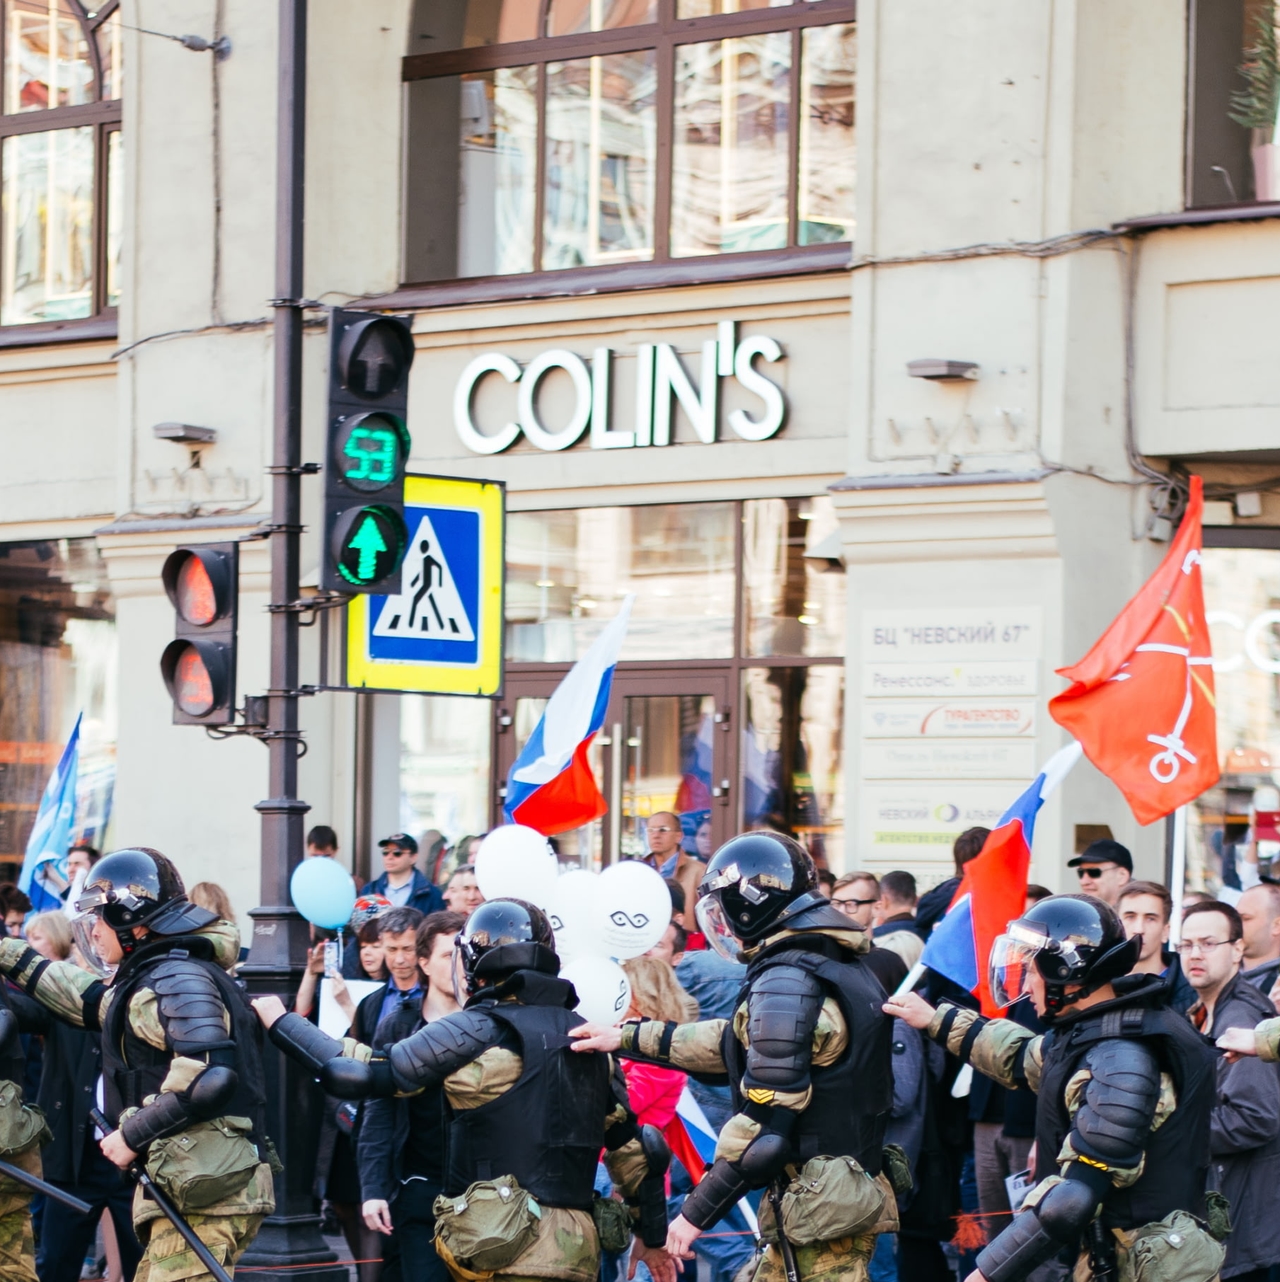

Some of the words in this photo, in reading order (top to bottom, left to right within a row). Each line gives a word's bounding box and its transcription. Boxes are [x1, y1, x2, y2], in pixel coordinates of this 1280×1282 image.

[454, 320, 786, 455] COLIN'S
[343, 428, 396, 481] 53
[874, 627, 897, 648] БЦ
